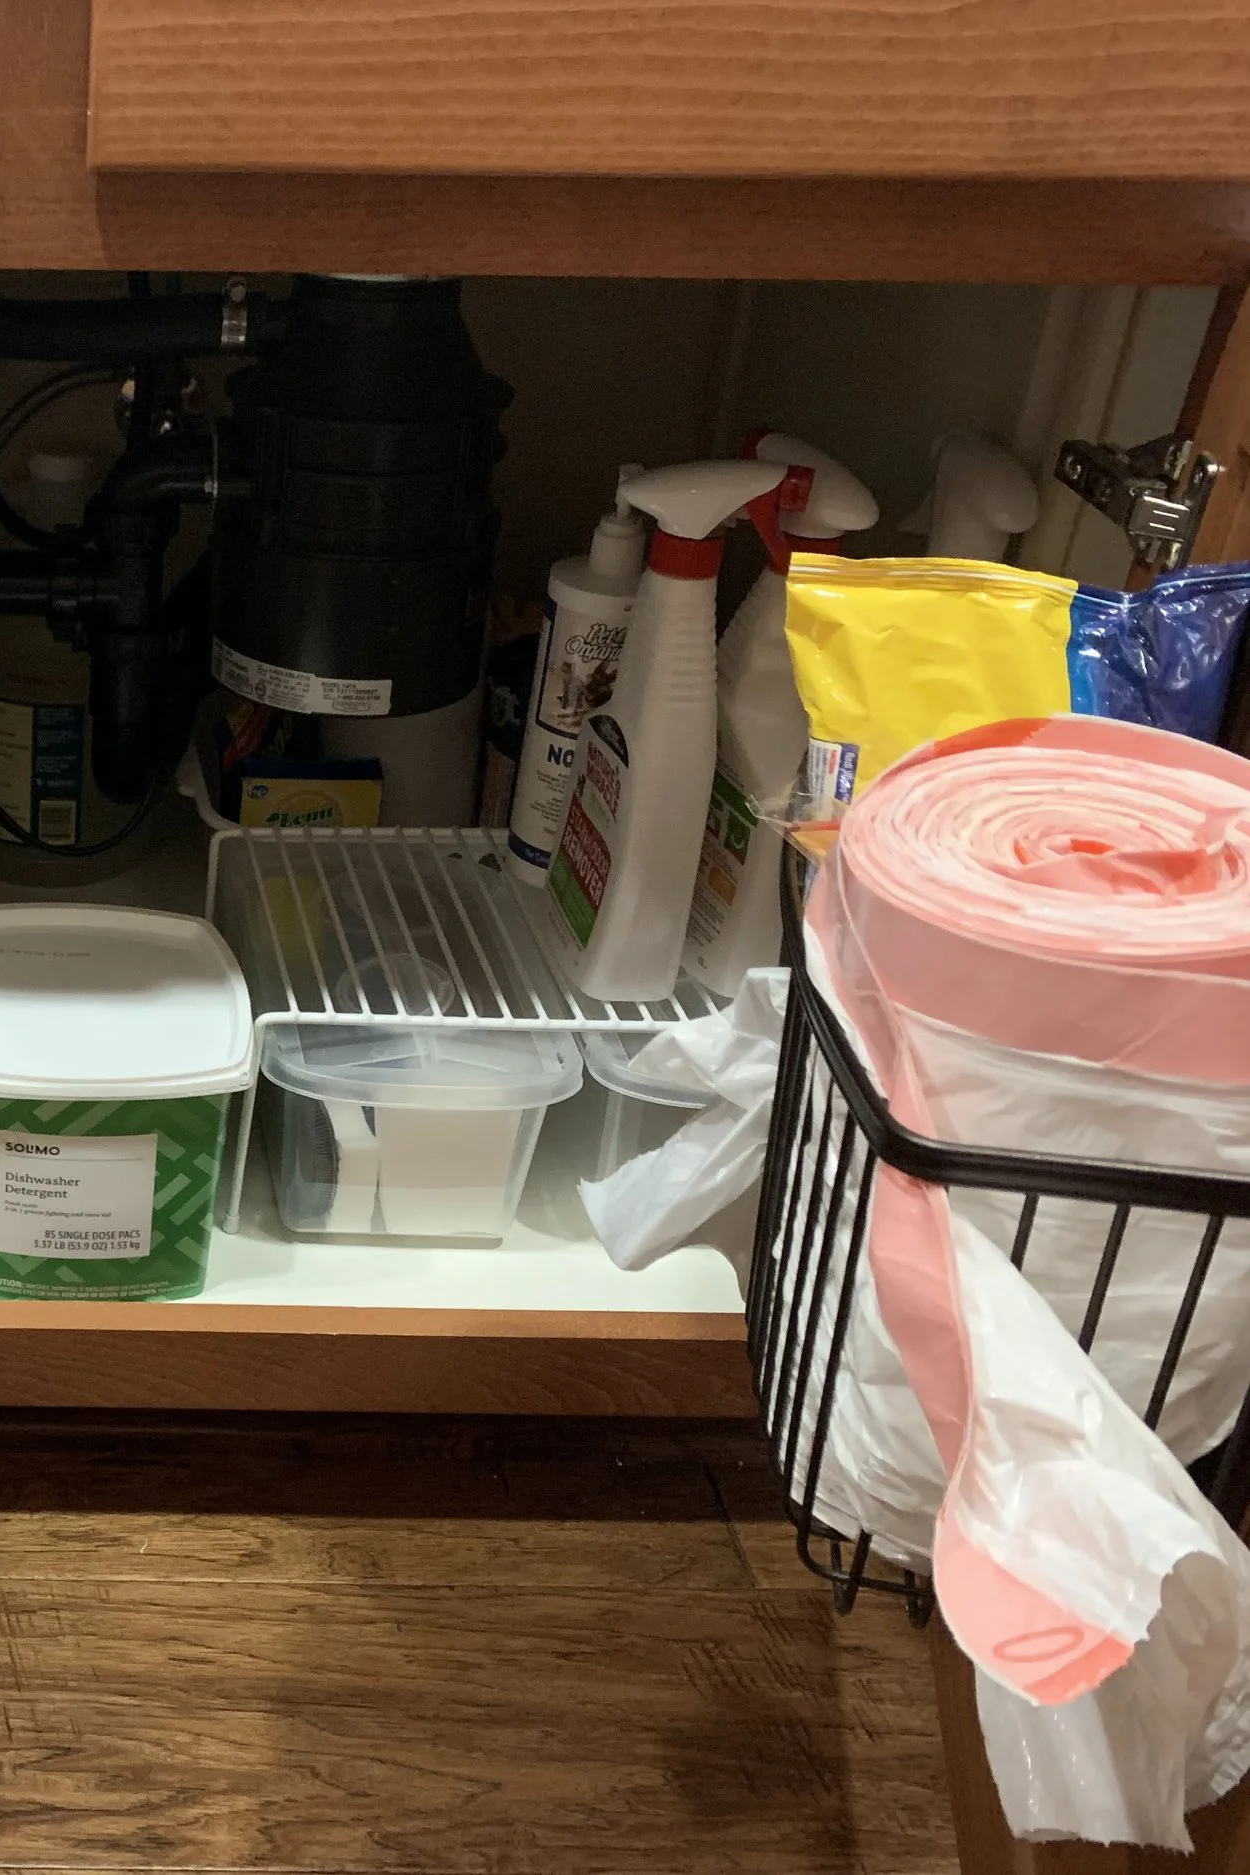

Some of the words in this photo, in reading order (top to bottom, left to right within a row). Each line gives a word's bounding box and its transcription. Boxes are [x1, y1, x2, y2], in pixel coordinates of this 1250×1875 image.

[563, 825, 603, 906] REMOVER
[5, 1171, 81, 1187] Dishwasher
[5, 1184, 69, 1200] Detergent
[44, 1229, 56, 1239] 85
[58, 1231, 90, 1240] SINGLE
[92, 1231, 116, 1240] DOSE
[118, 1230, 141, 1239] PACS
[34, 1240, 52, 1249] 3.37
[54, 1241, 66, 1250] LB
[67, 1242, 90, 1251] (53.9
[91, 1242, 108, 1251] OZ)
[111, 1241, 128, 1250] 1.53
[129, 1240, 141, 1251] kg
